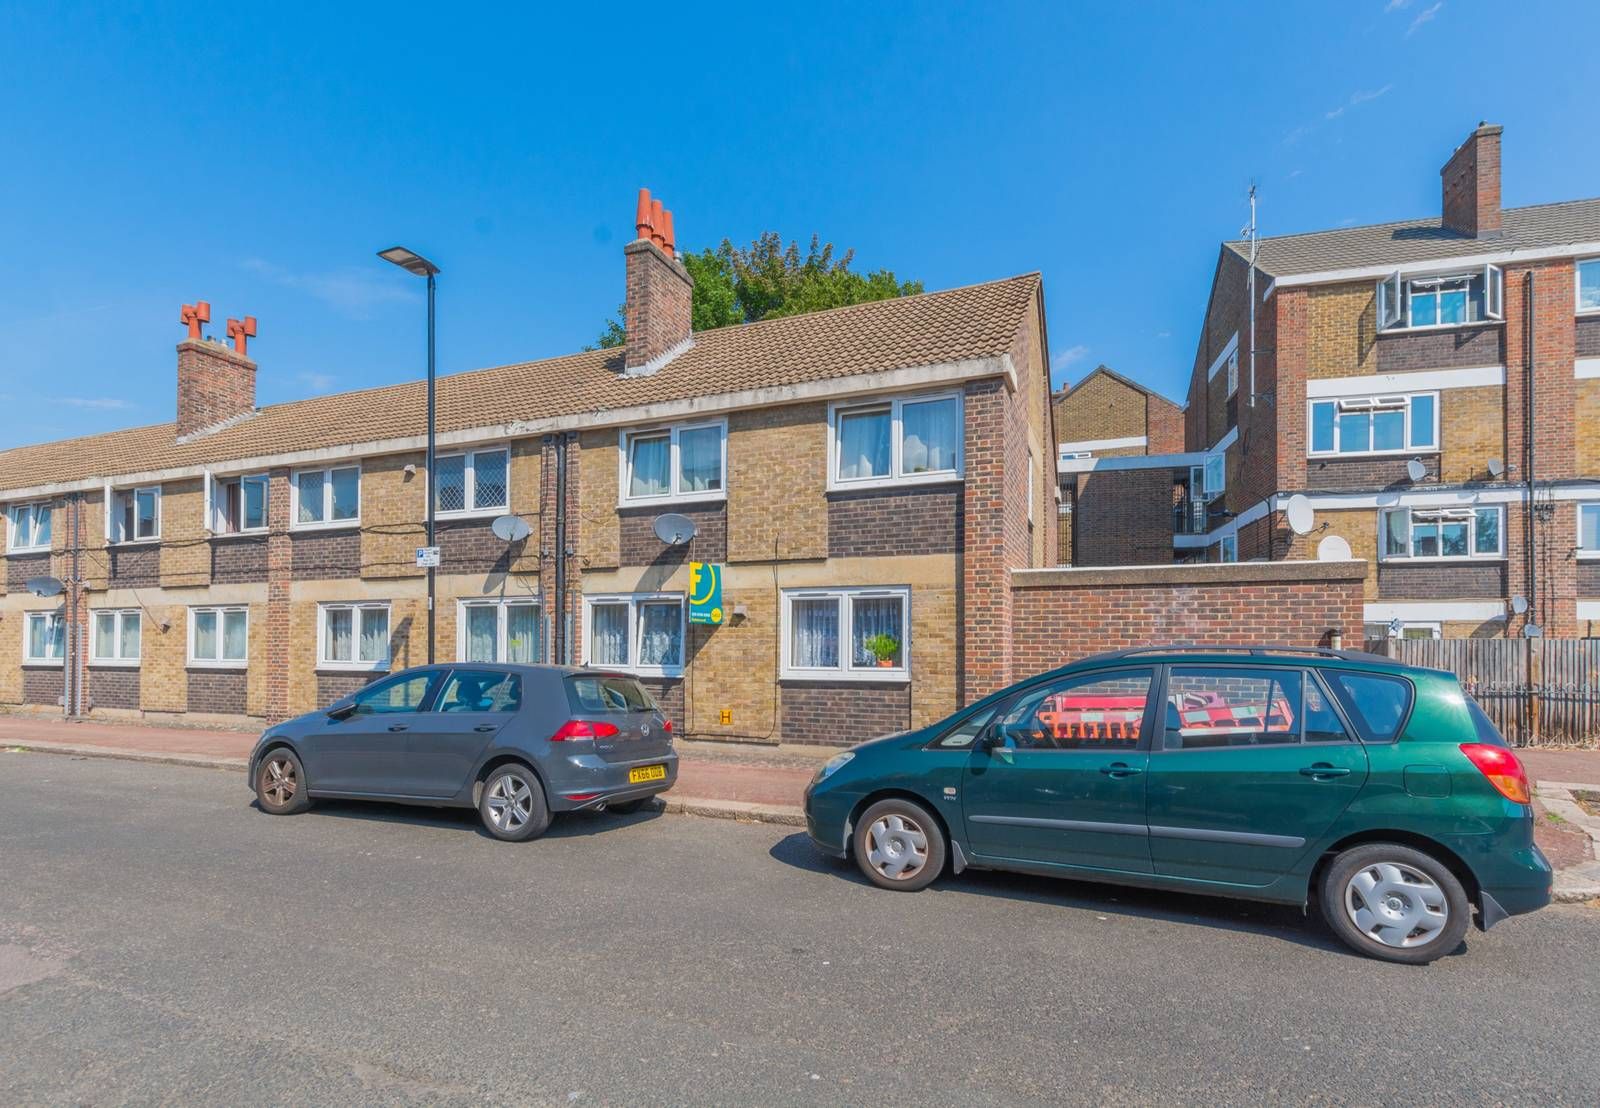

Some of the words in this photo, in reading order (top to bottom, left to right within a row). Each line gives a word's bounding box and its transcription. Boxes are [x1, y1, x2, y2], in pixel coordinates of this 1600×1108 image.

[690, 562, 703, 596] F
[721, 711, 731, 723] H
[631, 768, 650, 781] FX66
